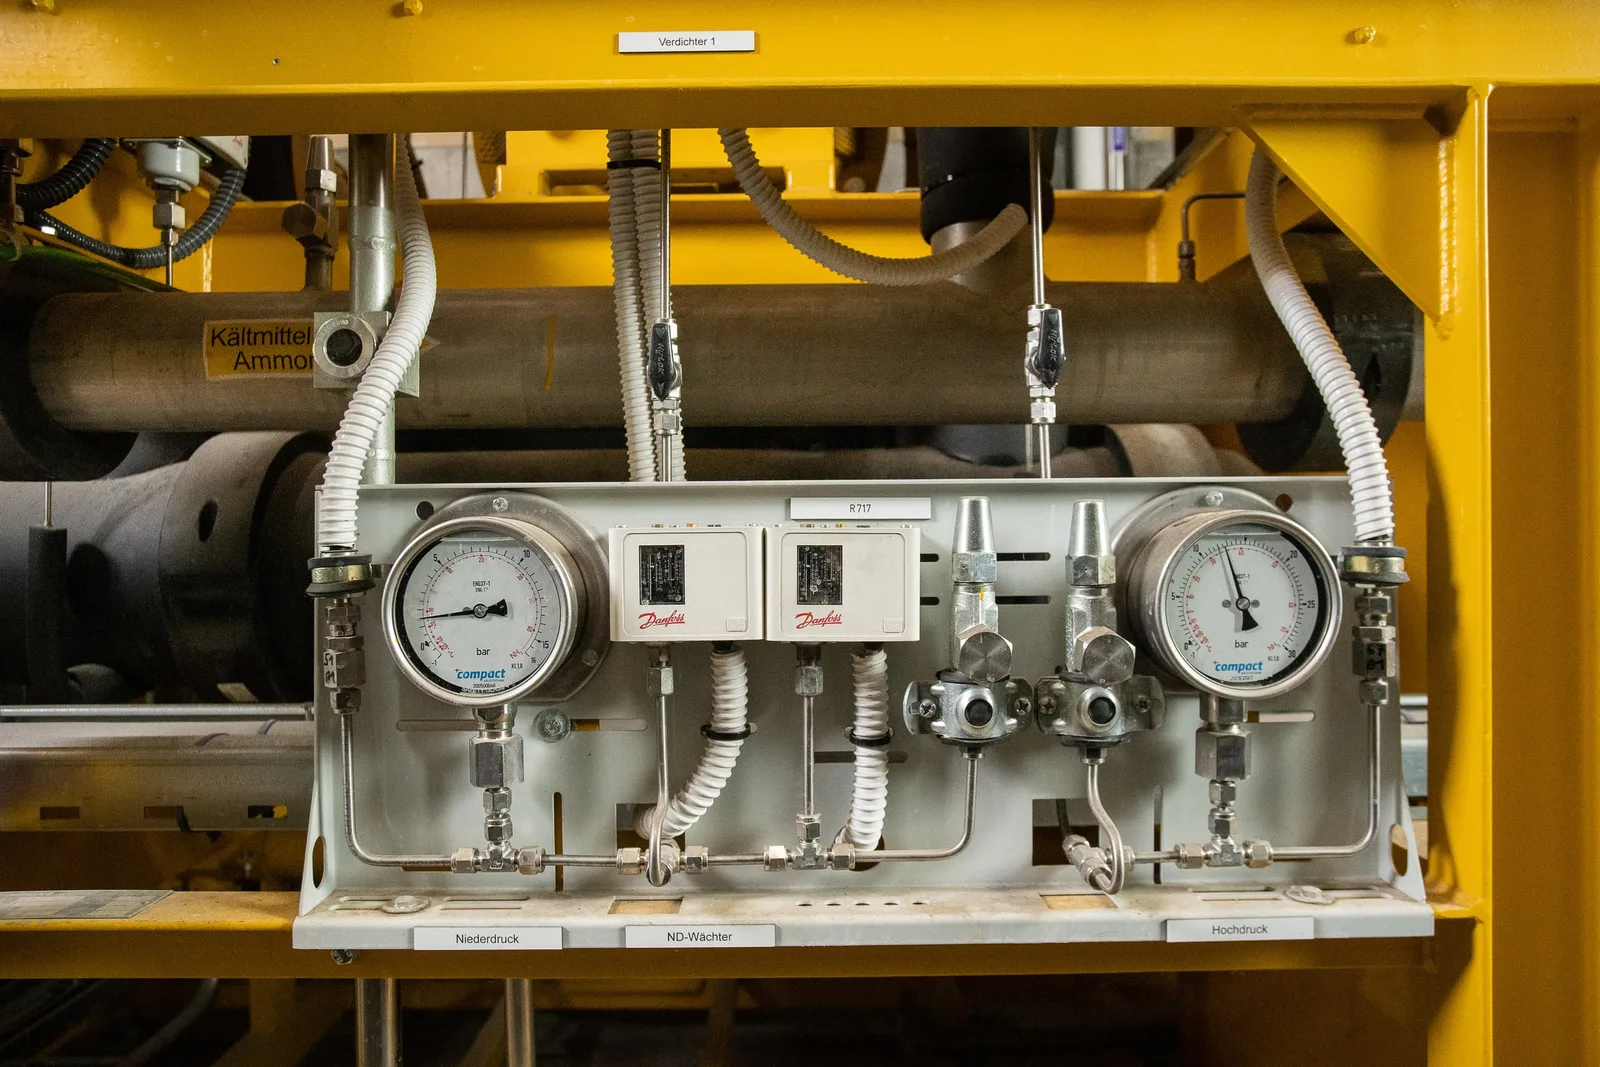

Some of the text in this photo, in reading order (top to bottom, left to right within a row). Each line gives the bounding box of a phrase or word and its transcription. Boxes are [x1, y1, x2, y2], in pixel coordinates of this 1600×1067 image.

[658, 37, 716, 47] Verdichter 1
[211, 325, 311, 347] Kältmittel
[1192, 543, 1200, 553] 10
[433, 553, 438, 562] 5
[523, 549, 531, 559] 10
[1289, 549, 1298, 559] 20
[1171, 591, 1176, 600] 5
[1306, 600, 1316, 609] 25
[638, 609, 685, 630] Danfoss
[795, 609, 842, 630] Danfoss
[420, 642, 425, 651] 0
[542, 640, 550, 649] 15
[1184, 642, 1189, 651] 0
[1234, 639, 1249, 649] bar
[476, 647, 491, 656] bar
[1288, 649, 1297, 659] 30
[1215, 661, 1263, 674] compact
[456, 668, 506, 681] compact
[1212, 924, 1268, 935] Hochdruck
[455, 933, 520, 944] Niederdruck
[667, 931, 733, 942] ND-Wächter
